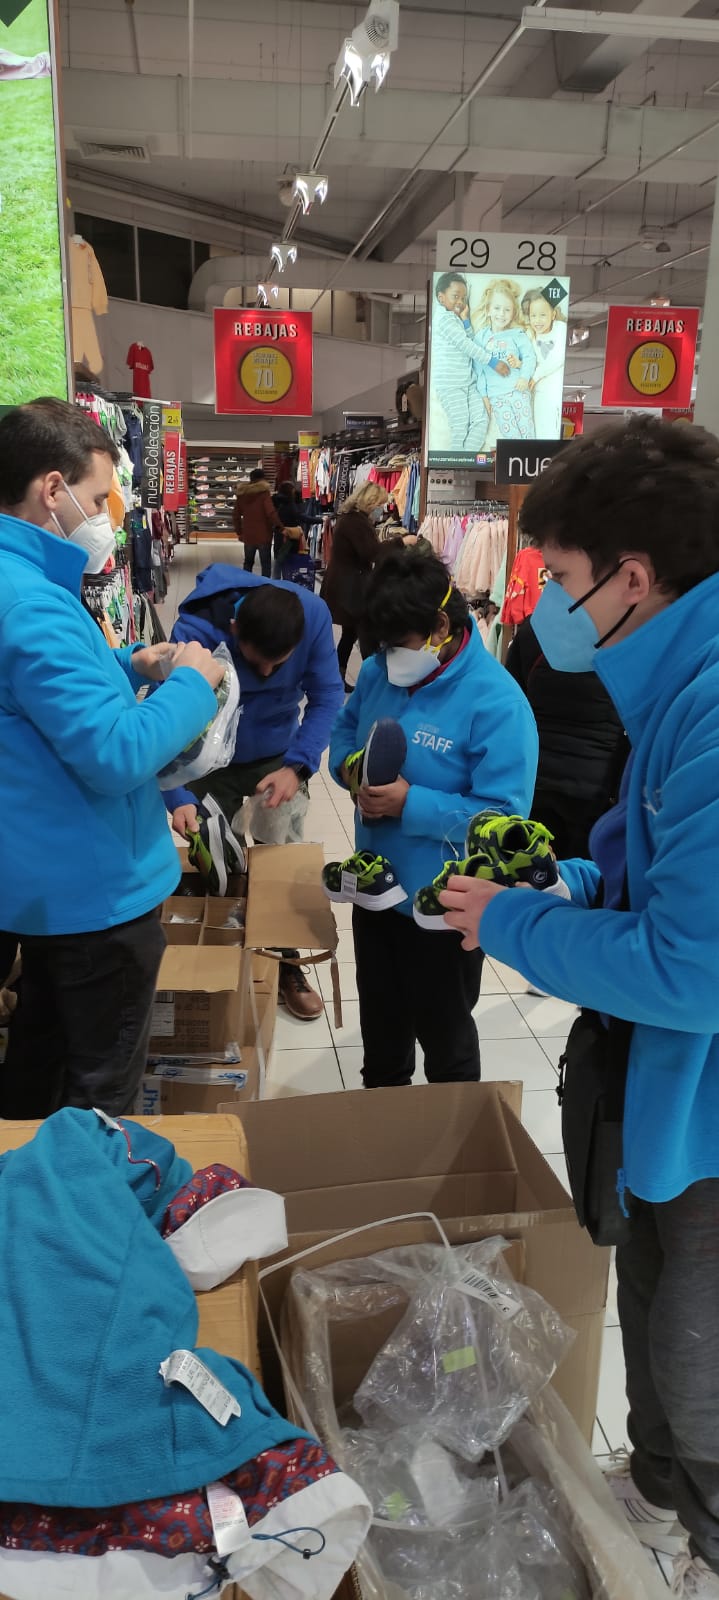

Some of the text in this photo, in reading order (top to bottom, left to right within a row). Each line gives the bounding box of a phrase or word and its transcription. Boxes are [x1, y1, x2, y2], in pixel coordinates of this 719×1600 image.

[449, 237, 490, 268] 29
[516, 240, 557, 271] 28
[548, 287, 560, 299] TEX
[233, 321, 298, 340] REBAJAS
[626, 318, 685, 336] REBAJAS
[254, 367, 275, 389] 70
[641, 362, 660, 383] 70
[145, 405, 160, 504] nuevaColección
[166, 451, 177, 494] REBAJAS
[412, 730, 453, 753] STAFF
